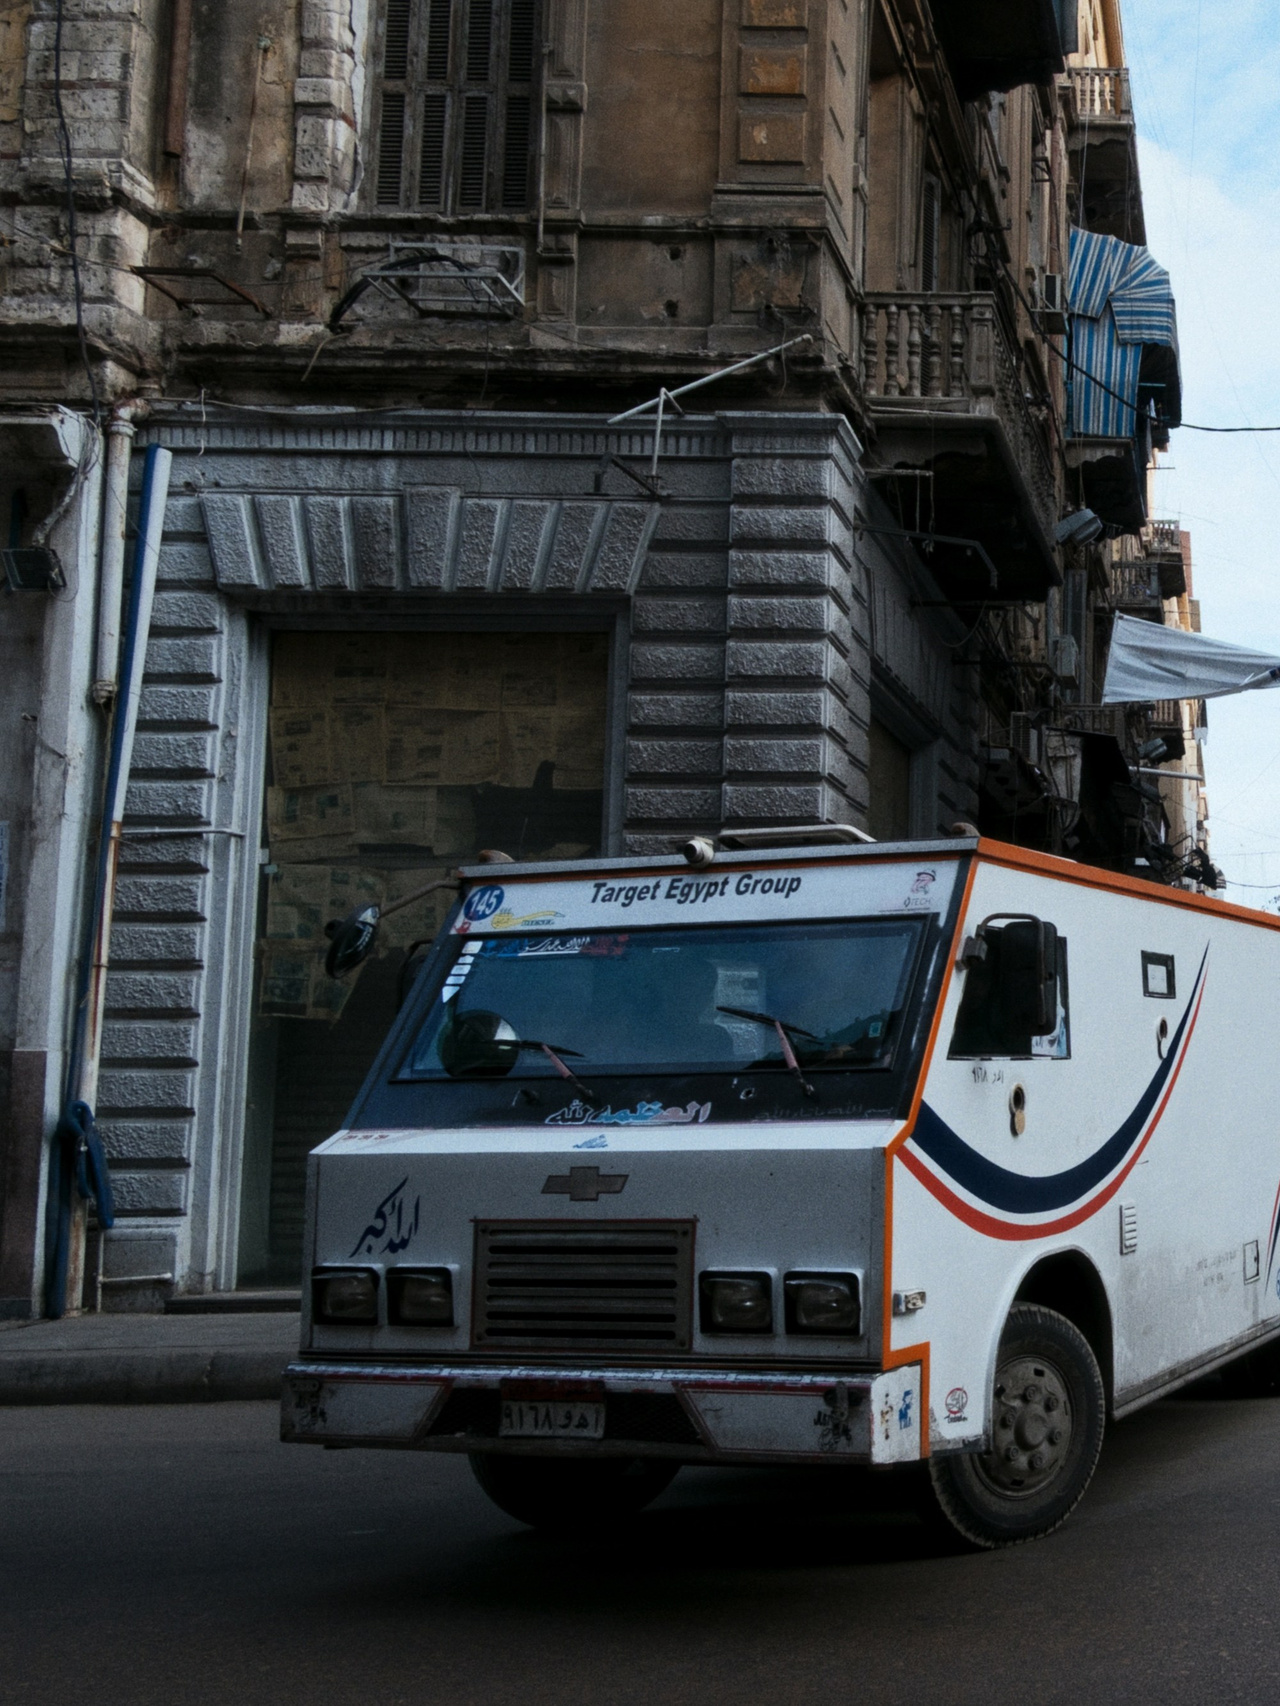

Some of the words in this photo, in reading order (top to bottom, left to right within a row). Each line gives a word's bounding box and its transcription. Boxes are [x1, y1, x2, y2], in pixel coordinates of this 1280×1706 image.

[468, 889, 501, 916] 145
[590, 879, 661, 908] Target
[664, 876, 729, 905] Egypt
[734, 873, 802, 899] Group
[503, 1404, 553, 1431] ٩١٦٨
